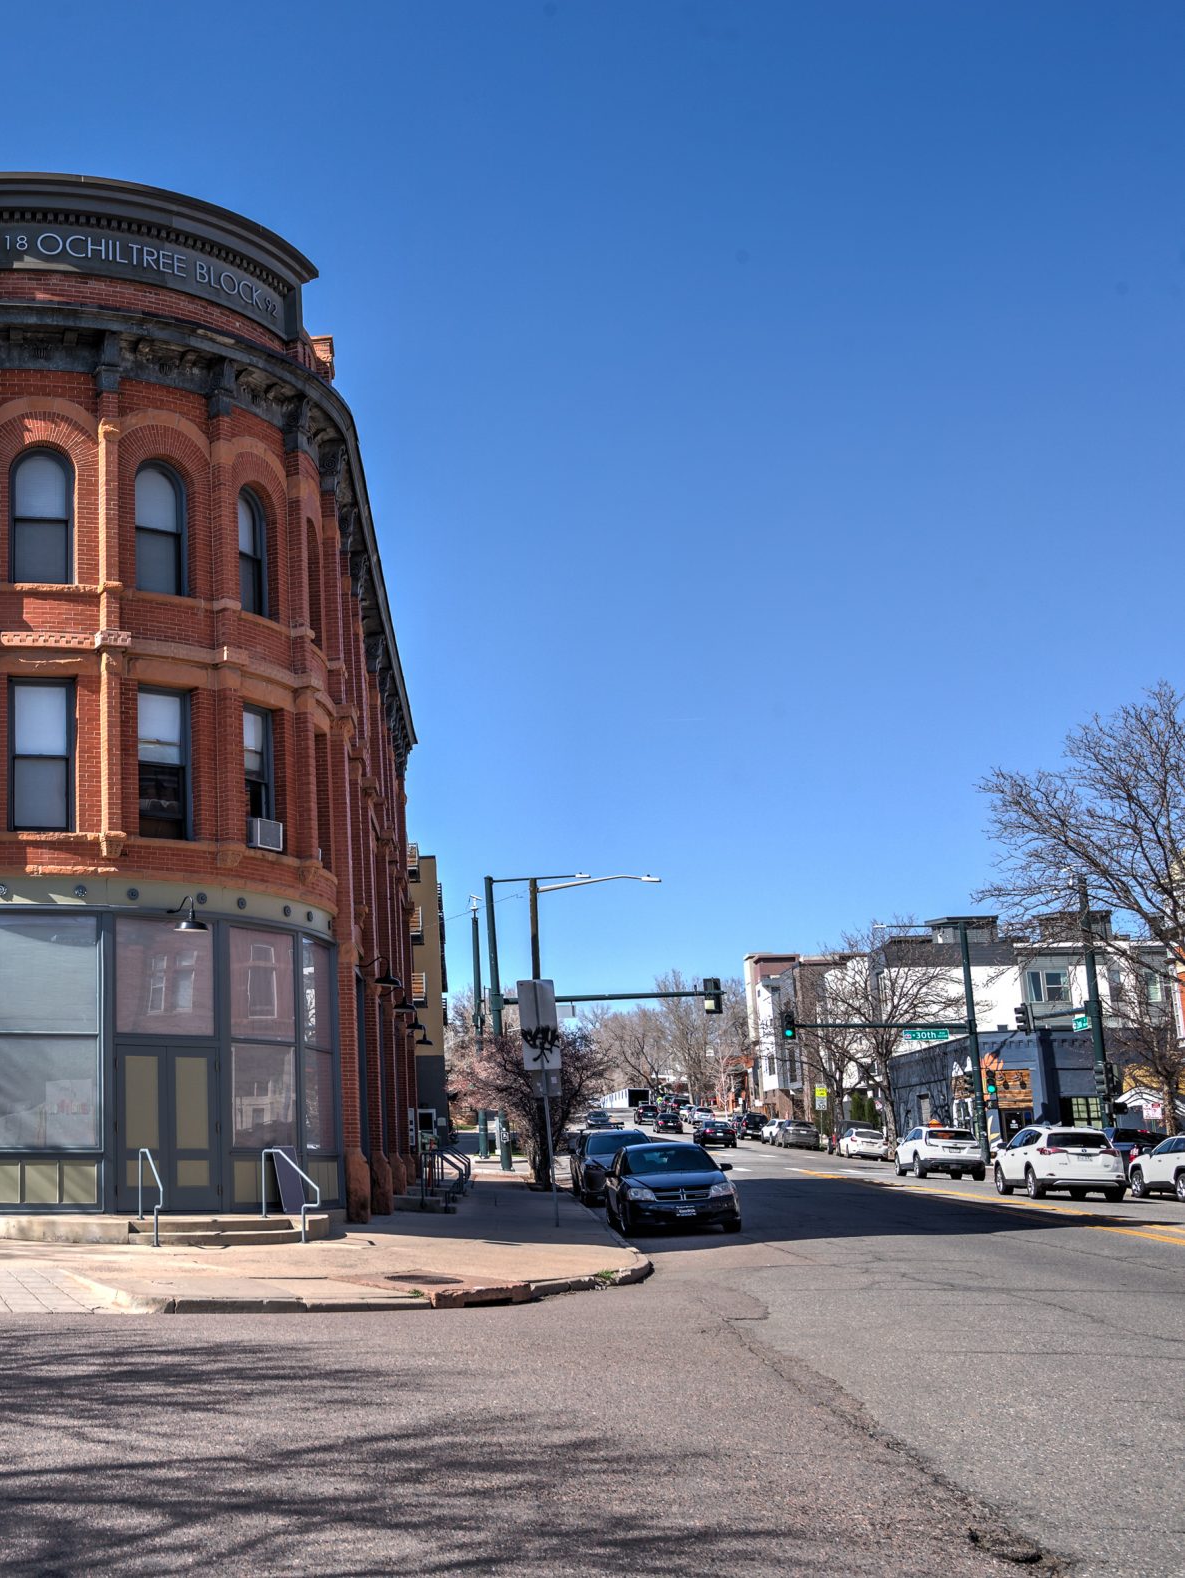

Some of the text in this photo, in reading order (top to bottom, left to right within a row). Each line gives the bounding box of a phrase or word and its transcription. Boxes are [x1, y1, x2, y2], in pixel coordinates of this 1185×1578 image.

[5, 233, 278, 319] 18 OCHILTREE BLOCK 92
[915, 1031, 937, 1039] 30th
